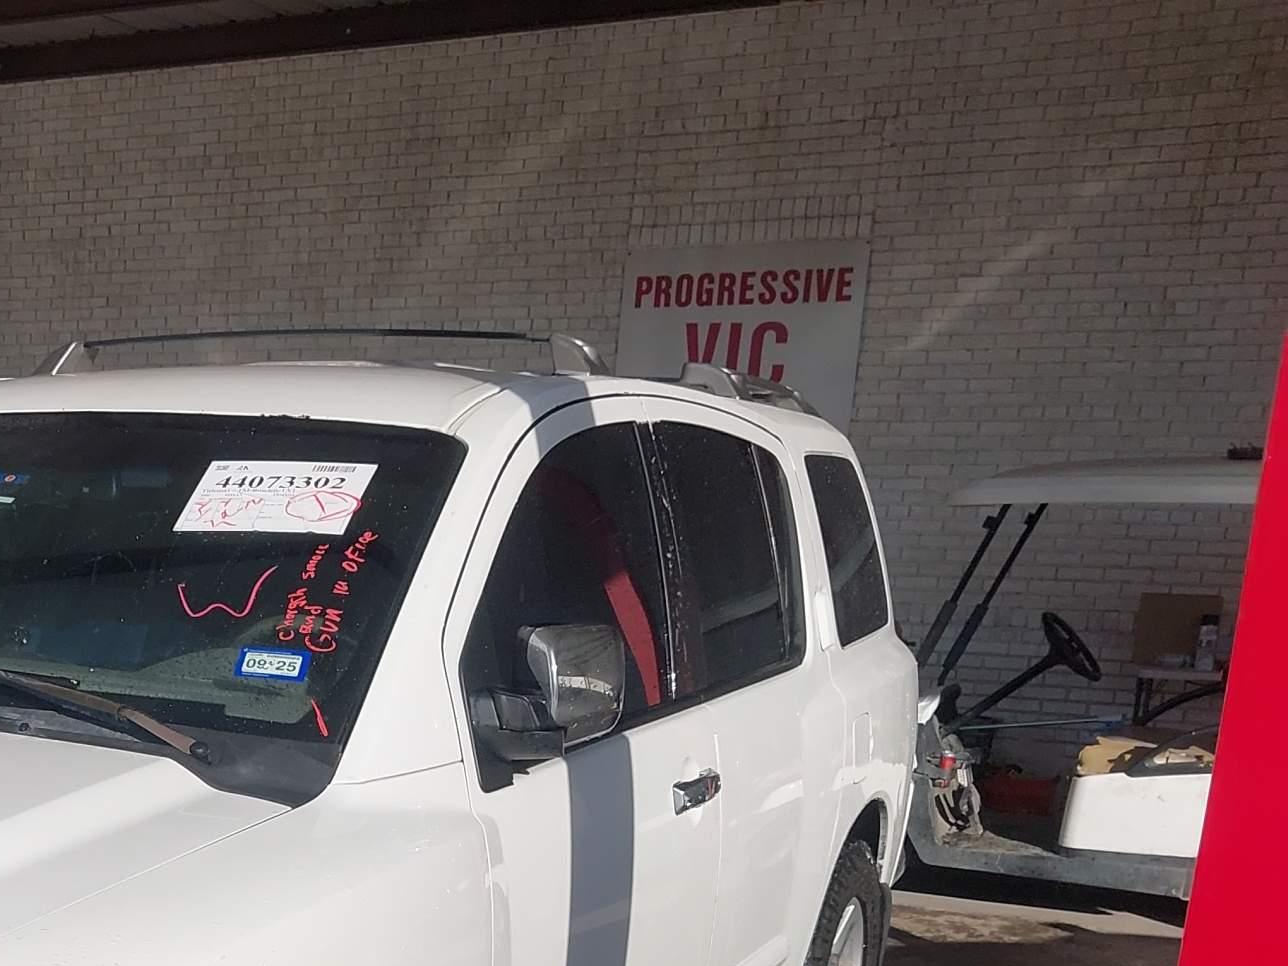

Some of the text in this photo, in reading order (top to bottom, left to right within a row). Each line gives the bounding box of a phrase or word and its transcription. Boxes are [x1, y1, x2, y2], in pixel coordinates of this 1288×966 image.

[634, 267, 854, 309] PROGRESSIVE
[685, 321, 789, 384] VIC
[215, 475, 347, 490] 44073302
[274, 660, 298, 673] 25
